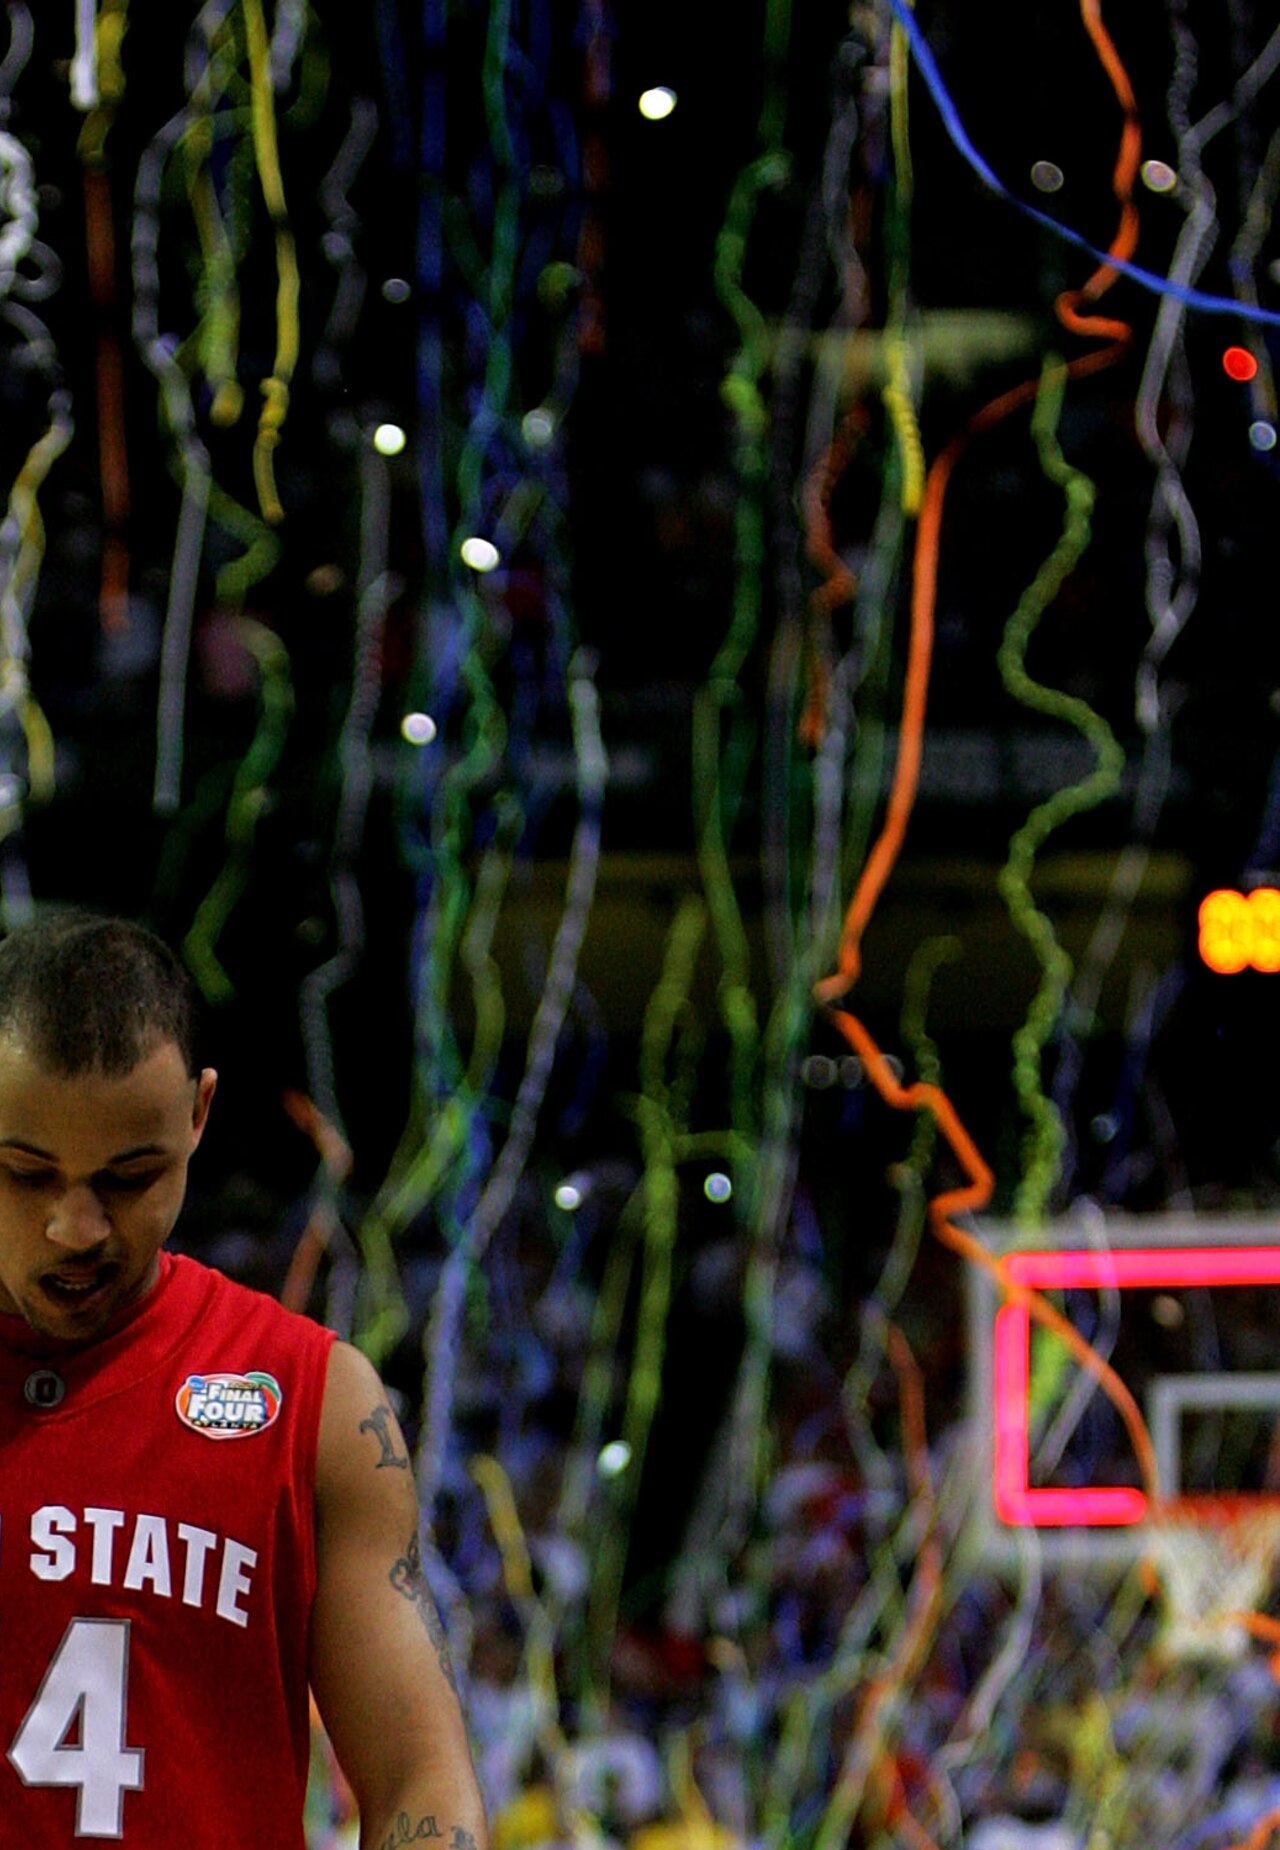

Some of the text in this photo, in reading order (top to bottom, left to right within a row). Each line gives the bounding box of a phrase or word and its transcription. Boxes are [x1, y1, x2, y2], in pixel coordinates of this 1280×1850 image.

[187, 1392, 265, 1423] FOUR
[208, 1382, 262, 1403] FINAL
[30, 1505, 258, 1628] STATE
